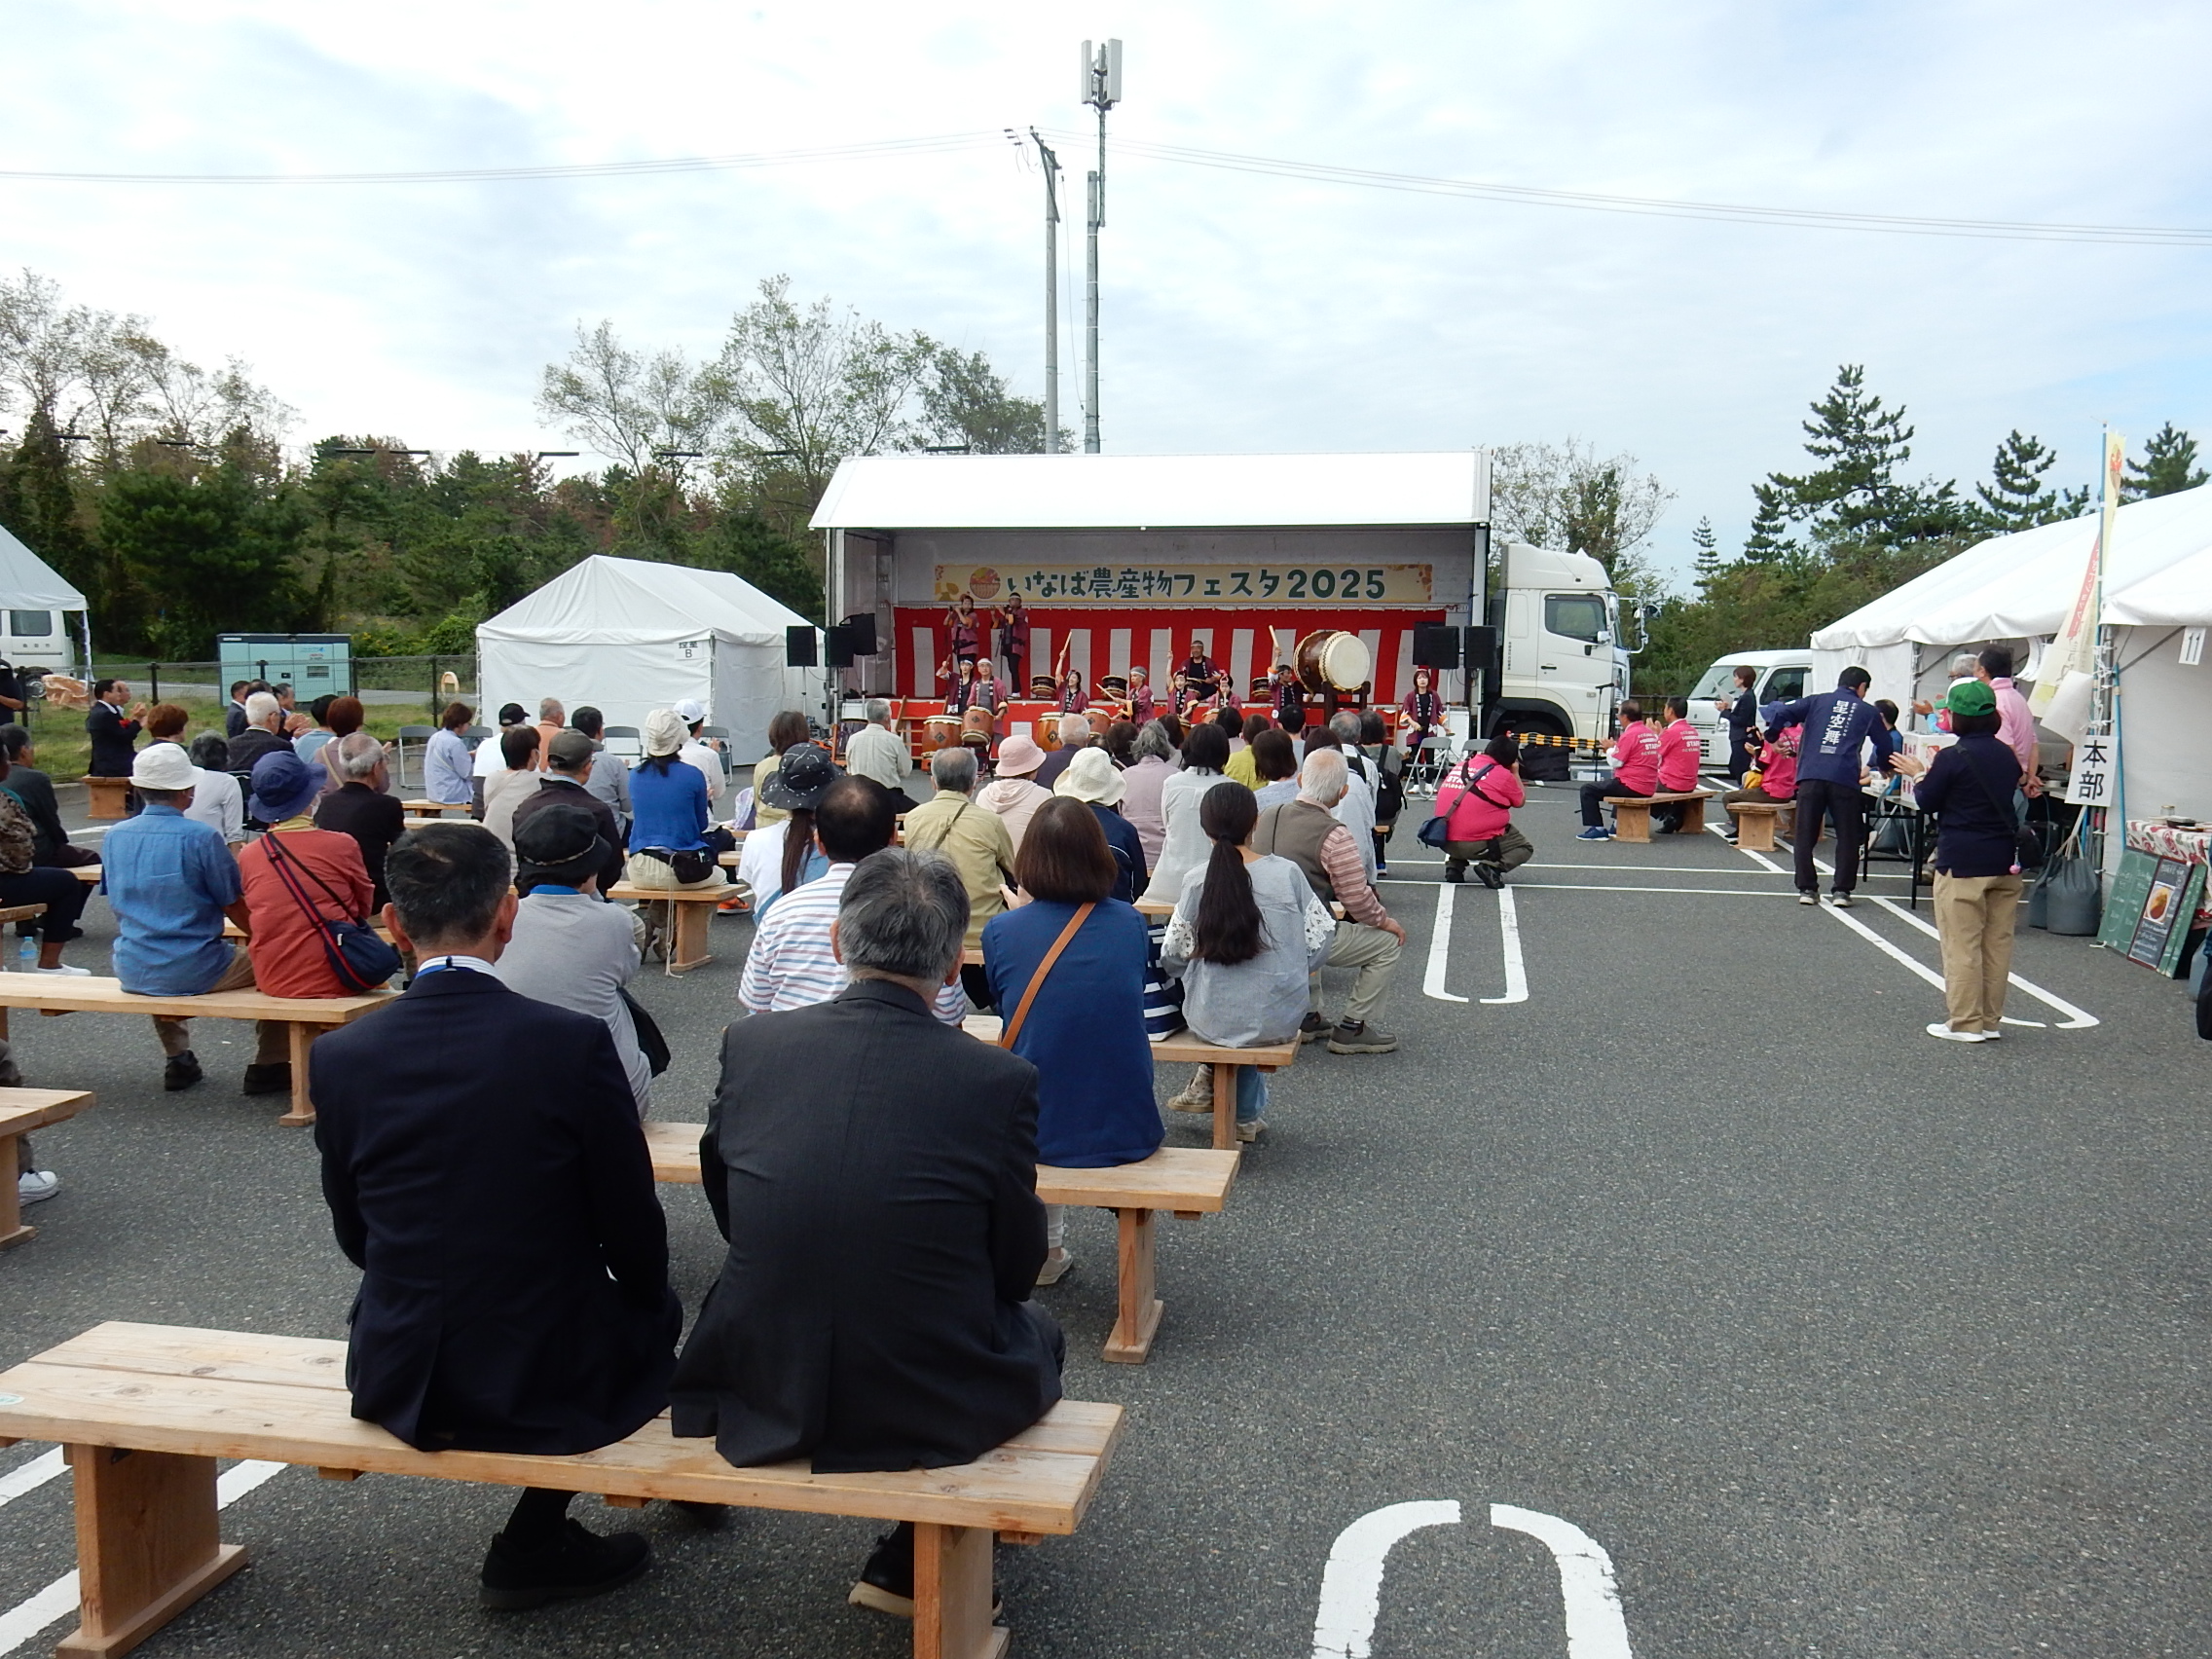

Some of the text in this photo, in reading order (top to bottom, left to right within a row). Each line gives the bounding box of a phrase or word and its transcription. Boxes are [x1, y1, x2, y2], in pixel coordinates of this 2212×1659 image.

[1007, 567, 1386, 600] いなば農産物フェスタ2025
[685, 648, 692, 657] B
[2185, 632, 2201, 662] 11
[1822, 699, 1850, 746] 星空舞
[2078, 739, 2108, 800] 本部
